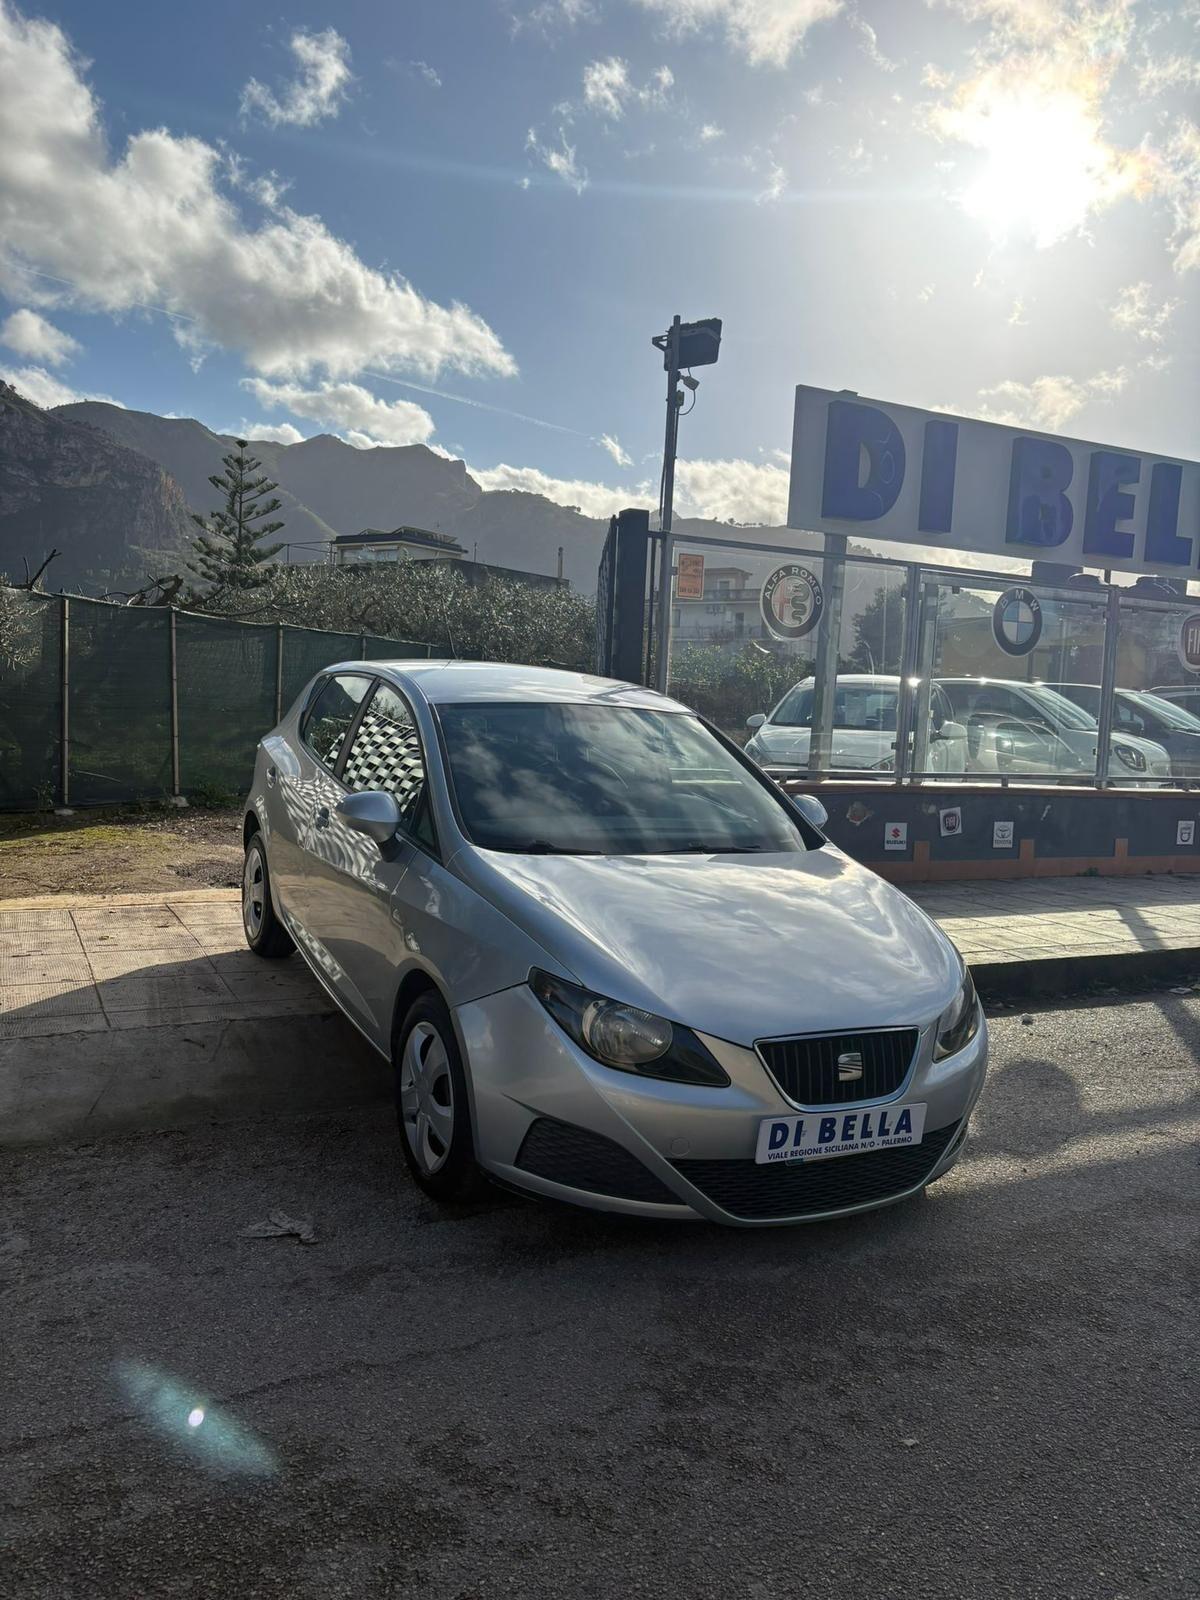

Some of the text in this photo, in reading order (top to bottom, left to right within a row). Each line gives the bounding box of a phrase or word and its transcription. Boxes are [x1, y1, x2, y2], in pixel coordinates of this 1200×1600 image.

[821, 400, 1200, 570] DI BEL
[765, 566, 822, 605] ALFA ROMEO
[768, 1109, 912, 1150] DI BELLA
[768, 1151, 788, 1160] VIALE
[790, 1146, 822, 1157] REGIONE
[824, 1144, 859, 1154] SICILIANA
[882, 1136, 912, 1147] PALERMO
